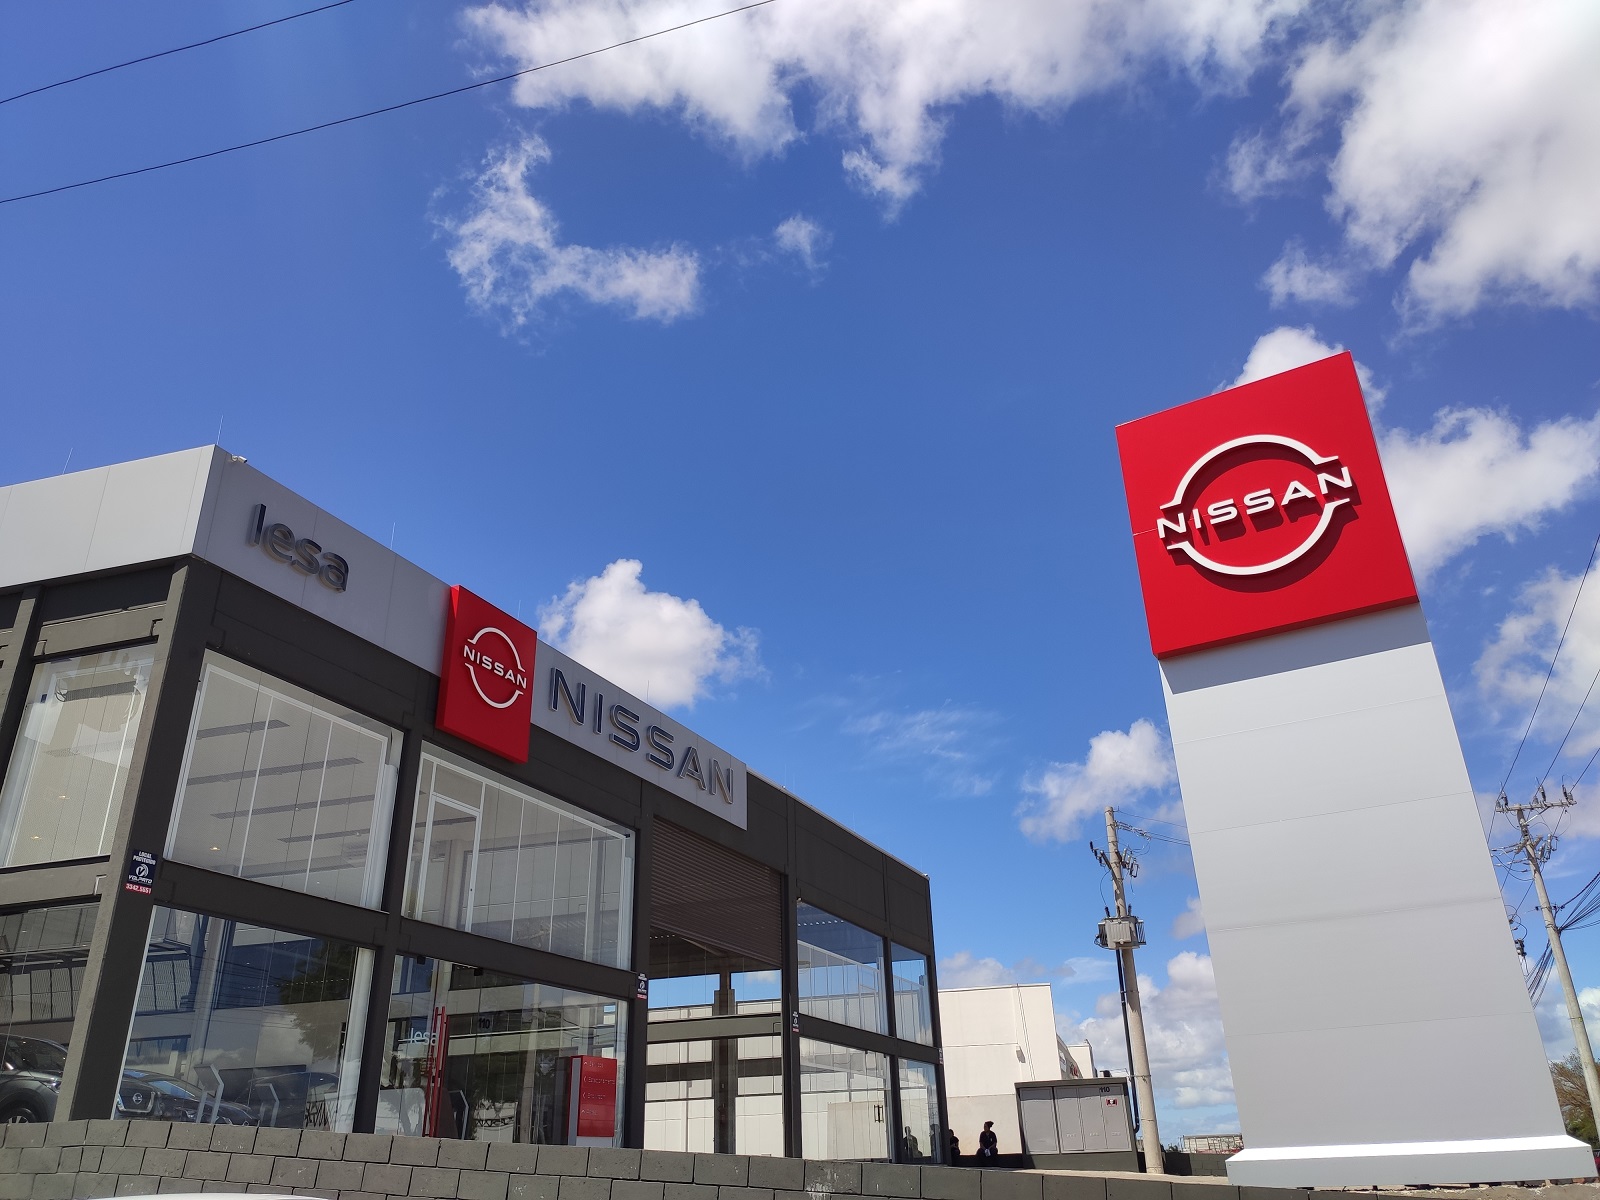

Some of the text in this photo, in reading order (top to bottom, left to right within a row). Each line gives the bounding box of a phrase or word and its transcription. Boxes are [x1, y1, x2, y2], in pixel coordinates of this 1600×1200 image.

[1157, 466, 1352, 538] NISSAN
[463, 644, 527, 689] NISSAN
[549, 666, 734, 804] NISSAN
[128, 875, 152, 883] VOLPATO
[478, 1017, 491, 1029] 110
